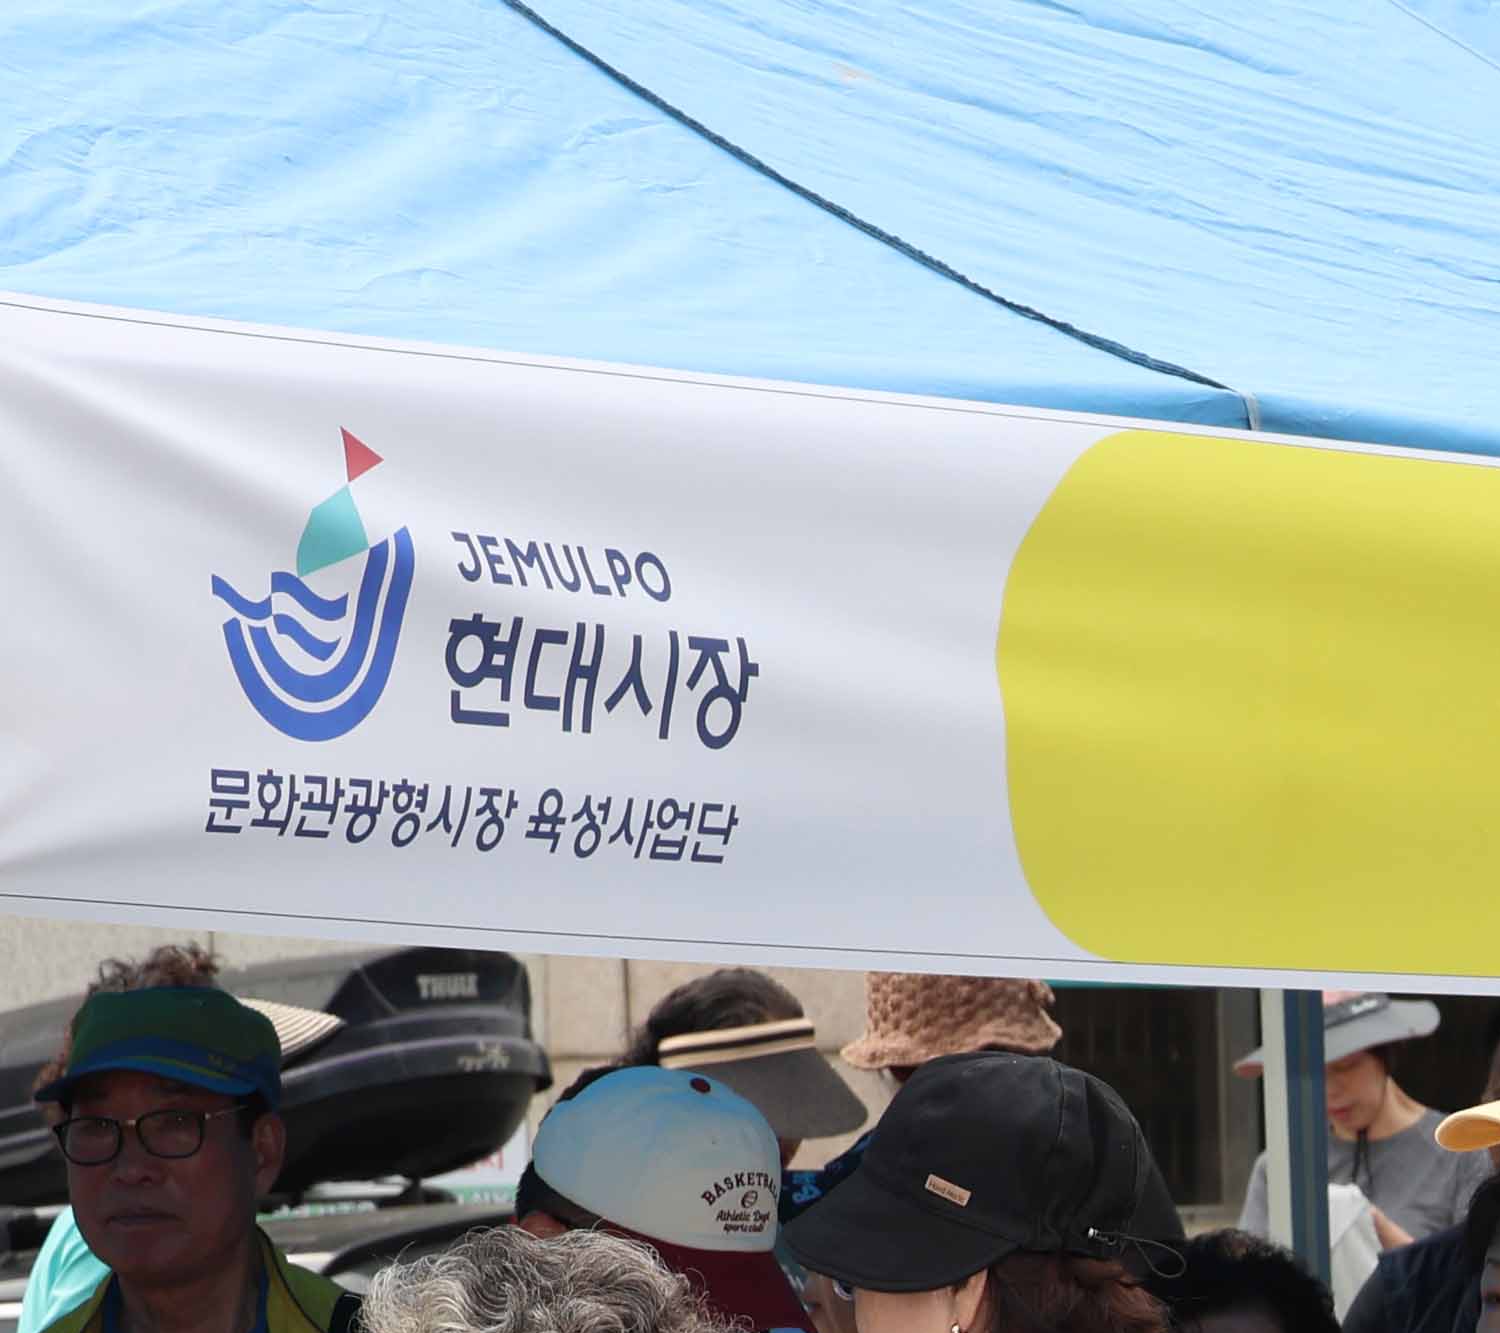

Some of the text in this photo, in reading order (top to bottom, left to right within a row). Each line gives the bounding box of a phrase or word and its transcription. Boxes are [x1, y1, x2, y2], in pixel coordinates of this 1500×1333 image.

[452, 530, 672, 602] JEMULPO
[444, 612, 760, 751] 현대시장
[204, 766, 740, 864] 문화관광형시장 육성사업단
